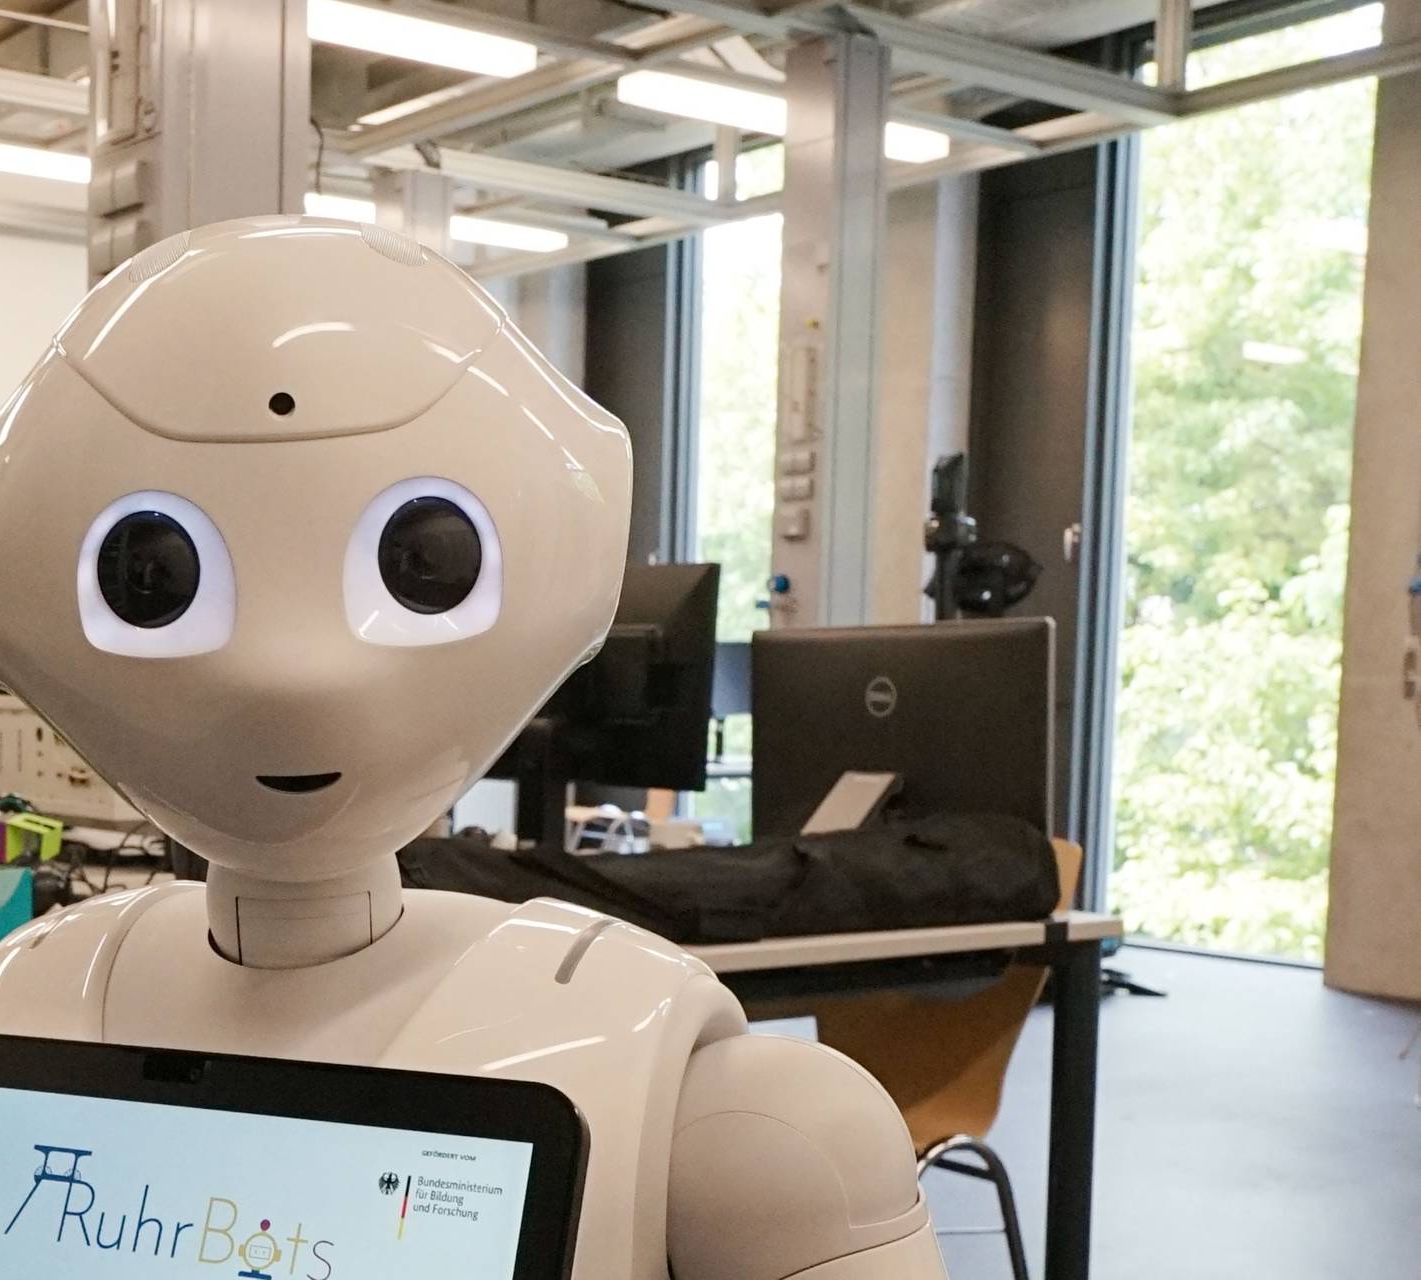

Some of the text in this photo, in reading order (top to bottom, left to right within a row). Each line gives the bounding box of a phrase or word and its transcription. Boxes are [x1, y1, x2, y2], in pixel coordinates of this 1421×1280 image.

[422, 1150, 477, 1162] GEFÖRDERT VOM
[417, 1176, 503, 1196] Bundesministerium
[415, 1189, 465, 1206] für Bildung
[412, 1203, 479, 1221] und Forschung
[56, 1177, 335, 1280] RuhrBots
